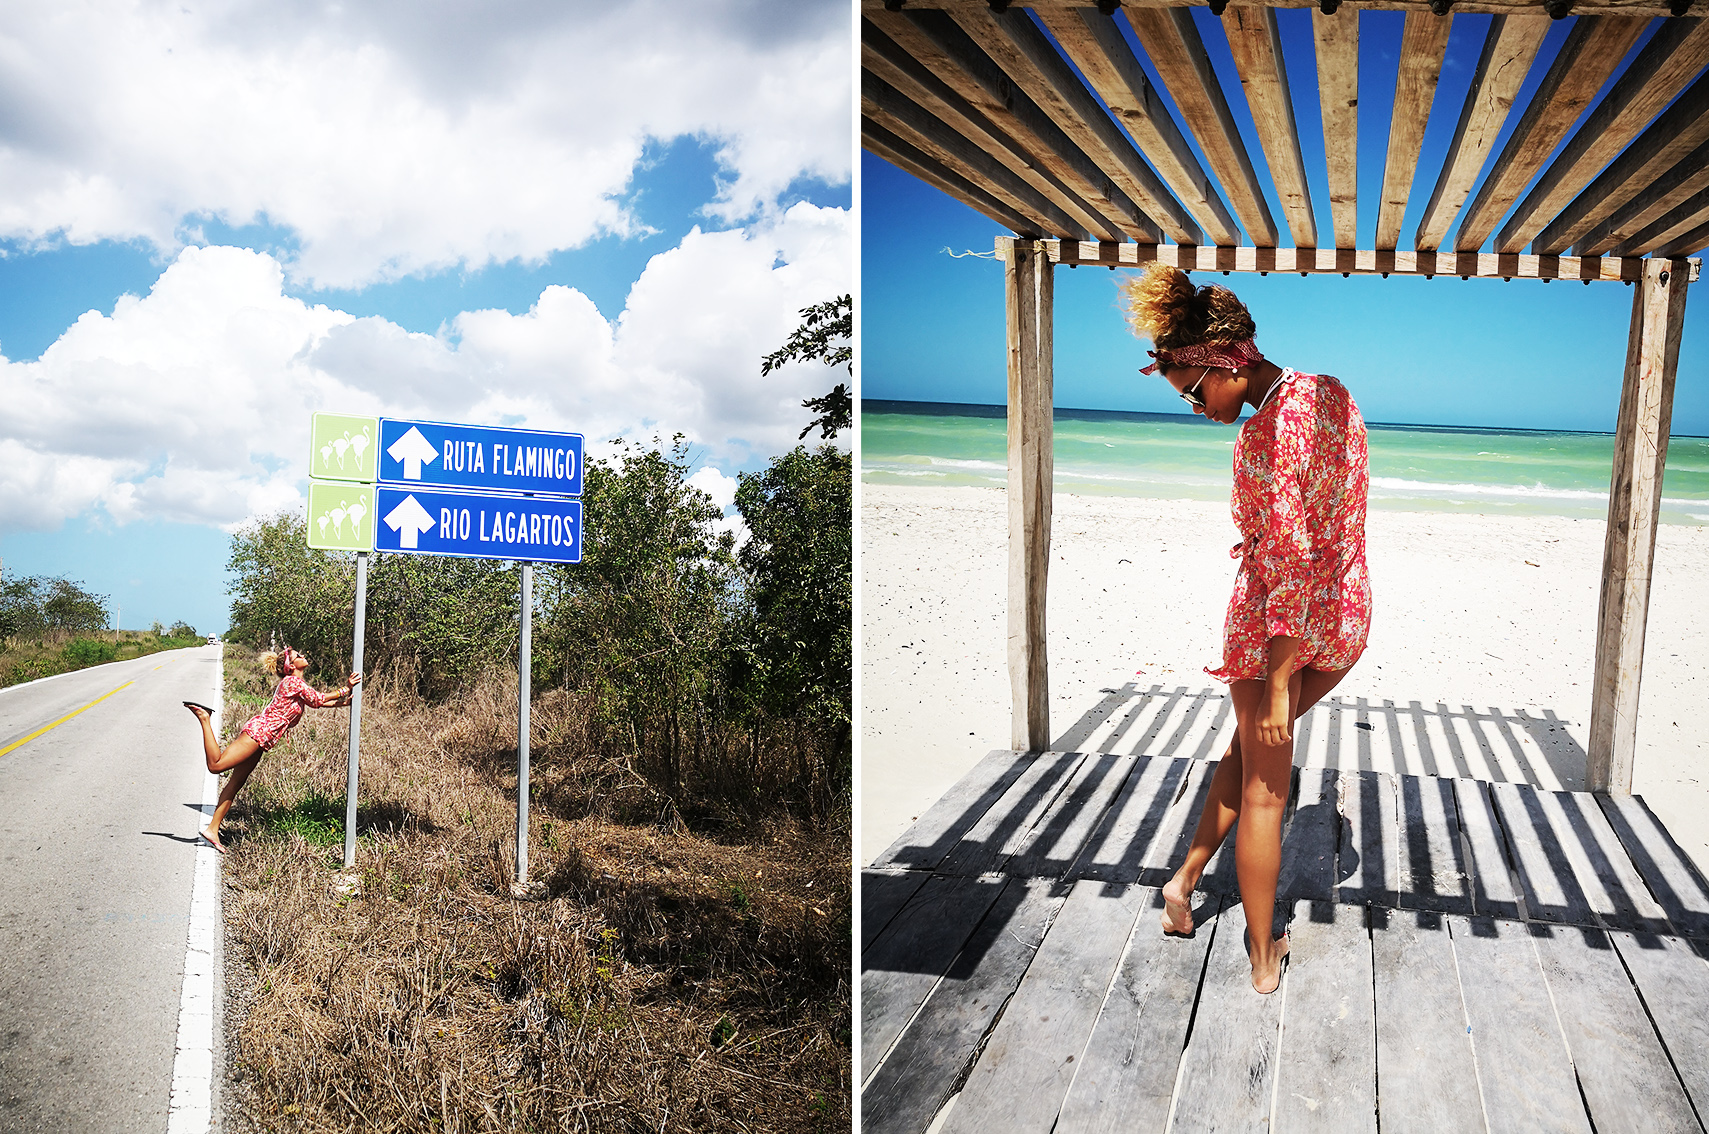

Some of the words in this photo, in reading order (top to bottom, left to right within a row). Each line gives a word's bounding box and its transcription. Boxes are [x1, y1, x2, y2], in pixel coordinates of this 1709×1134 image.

[443, 439, 485, 474] RUTA
[493, 443, 575, 480] FLAMINGO
[440, 507, 471, 541] RIO
[479, 510, 574, 547] LAGARTOS
